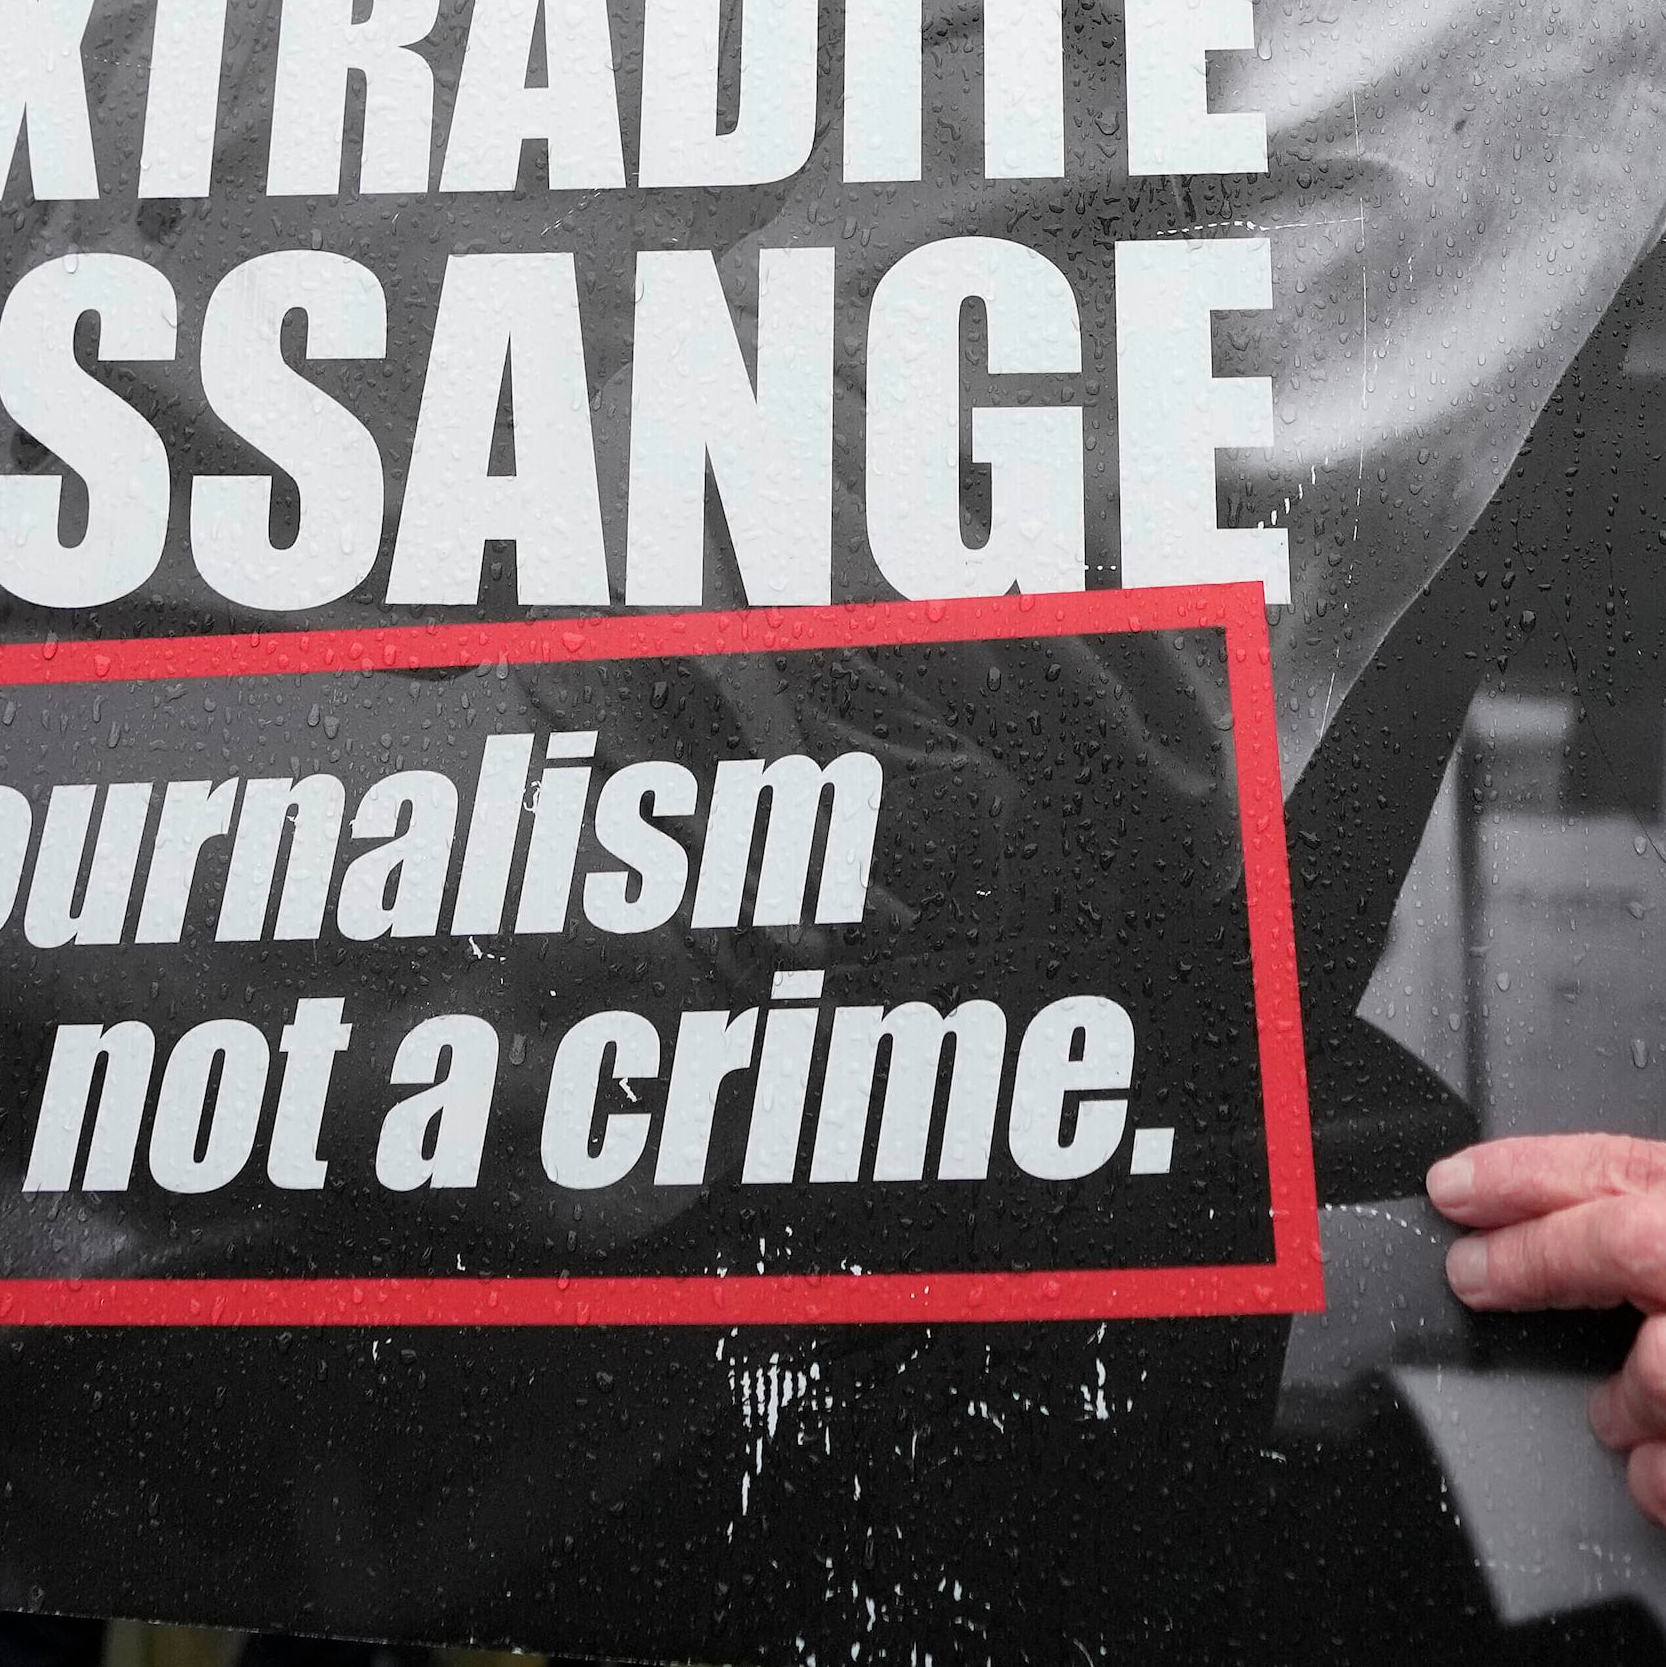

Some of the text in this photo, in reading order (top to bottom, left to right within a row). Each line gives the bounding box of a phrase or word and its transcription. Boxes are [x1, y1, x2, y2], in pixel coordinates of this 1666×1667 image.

[22, 997, 352, 1197] not
[375, 1014, 500, 1194] a
[539, 970, 1175, 1191] crime.
